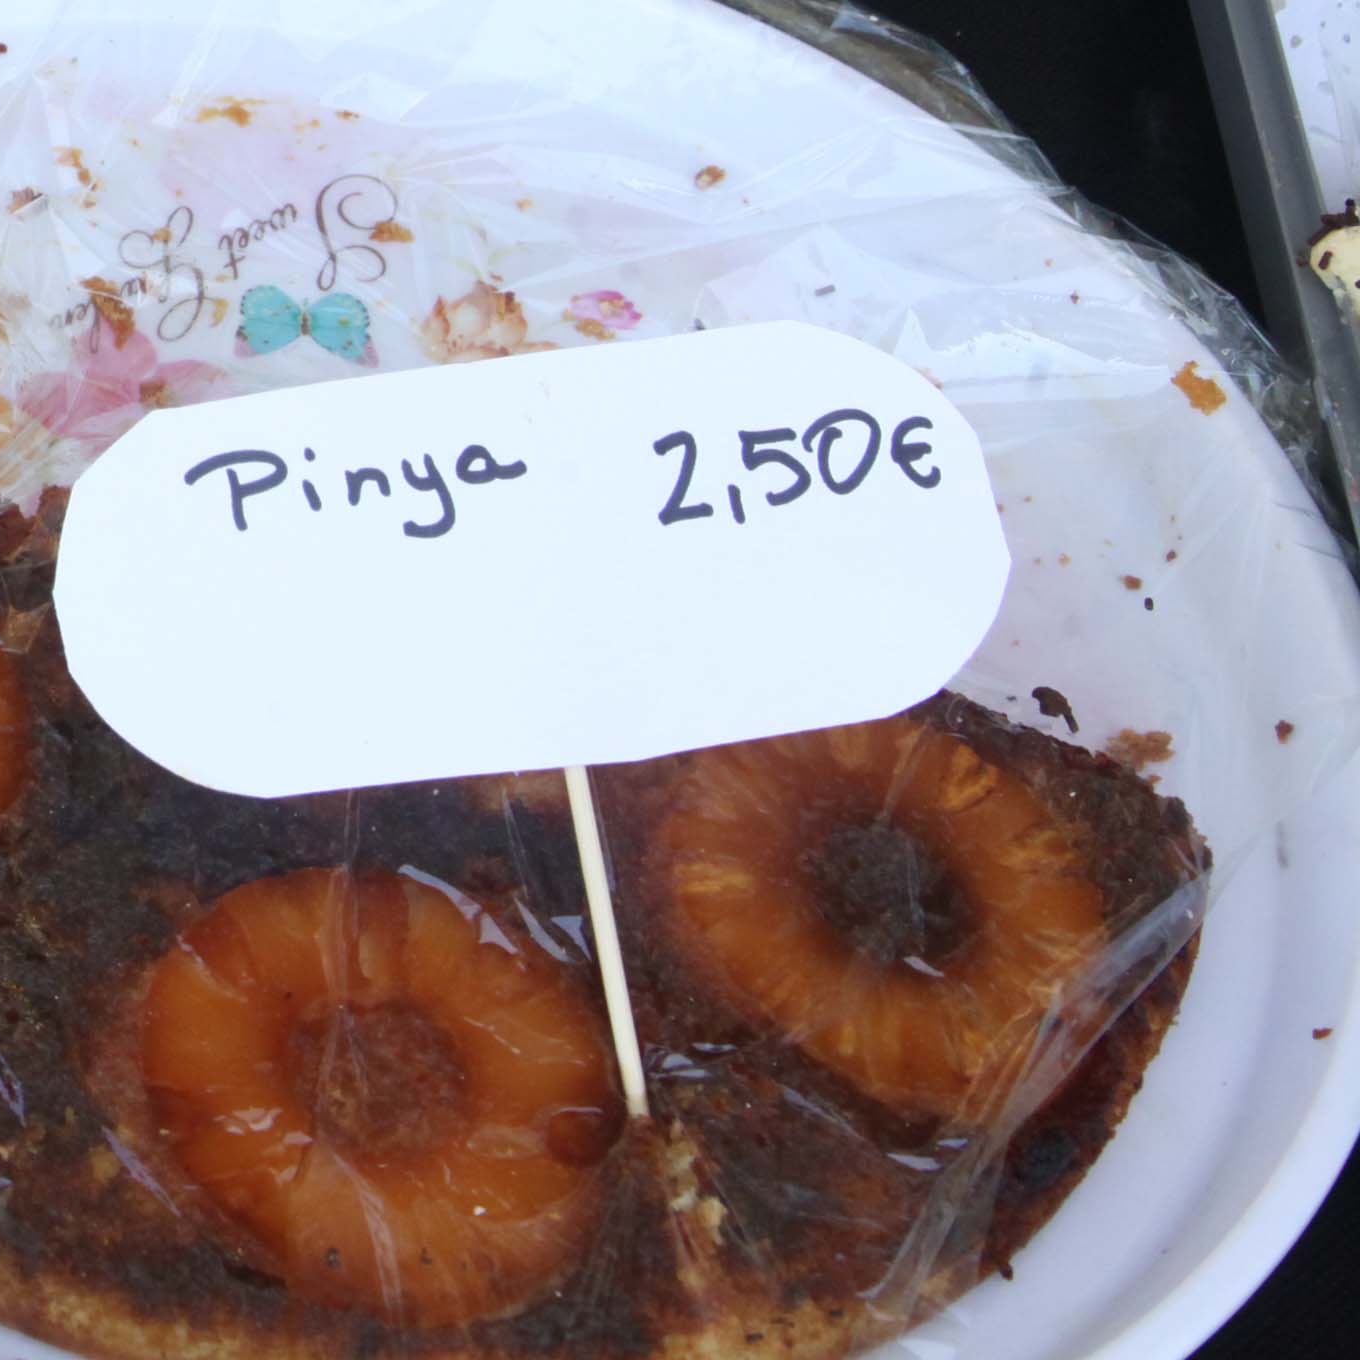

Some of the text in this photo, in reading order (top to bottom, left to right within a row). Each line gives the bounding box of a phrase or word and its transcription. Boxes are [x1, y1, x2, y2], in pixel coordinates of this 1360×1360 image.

[219, 174, 398, 291] Sweet
[185, 408, 943, 539] Pinya 2,50€
